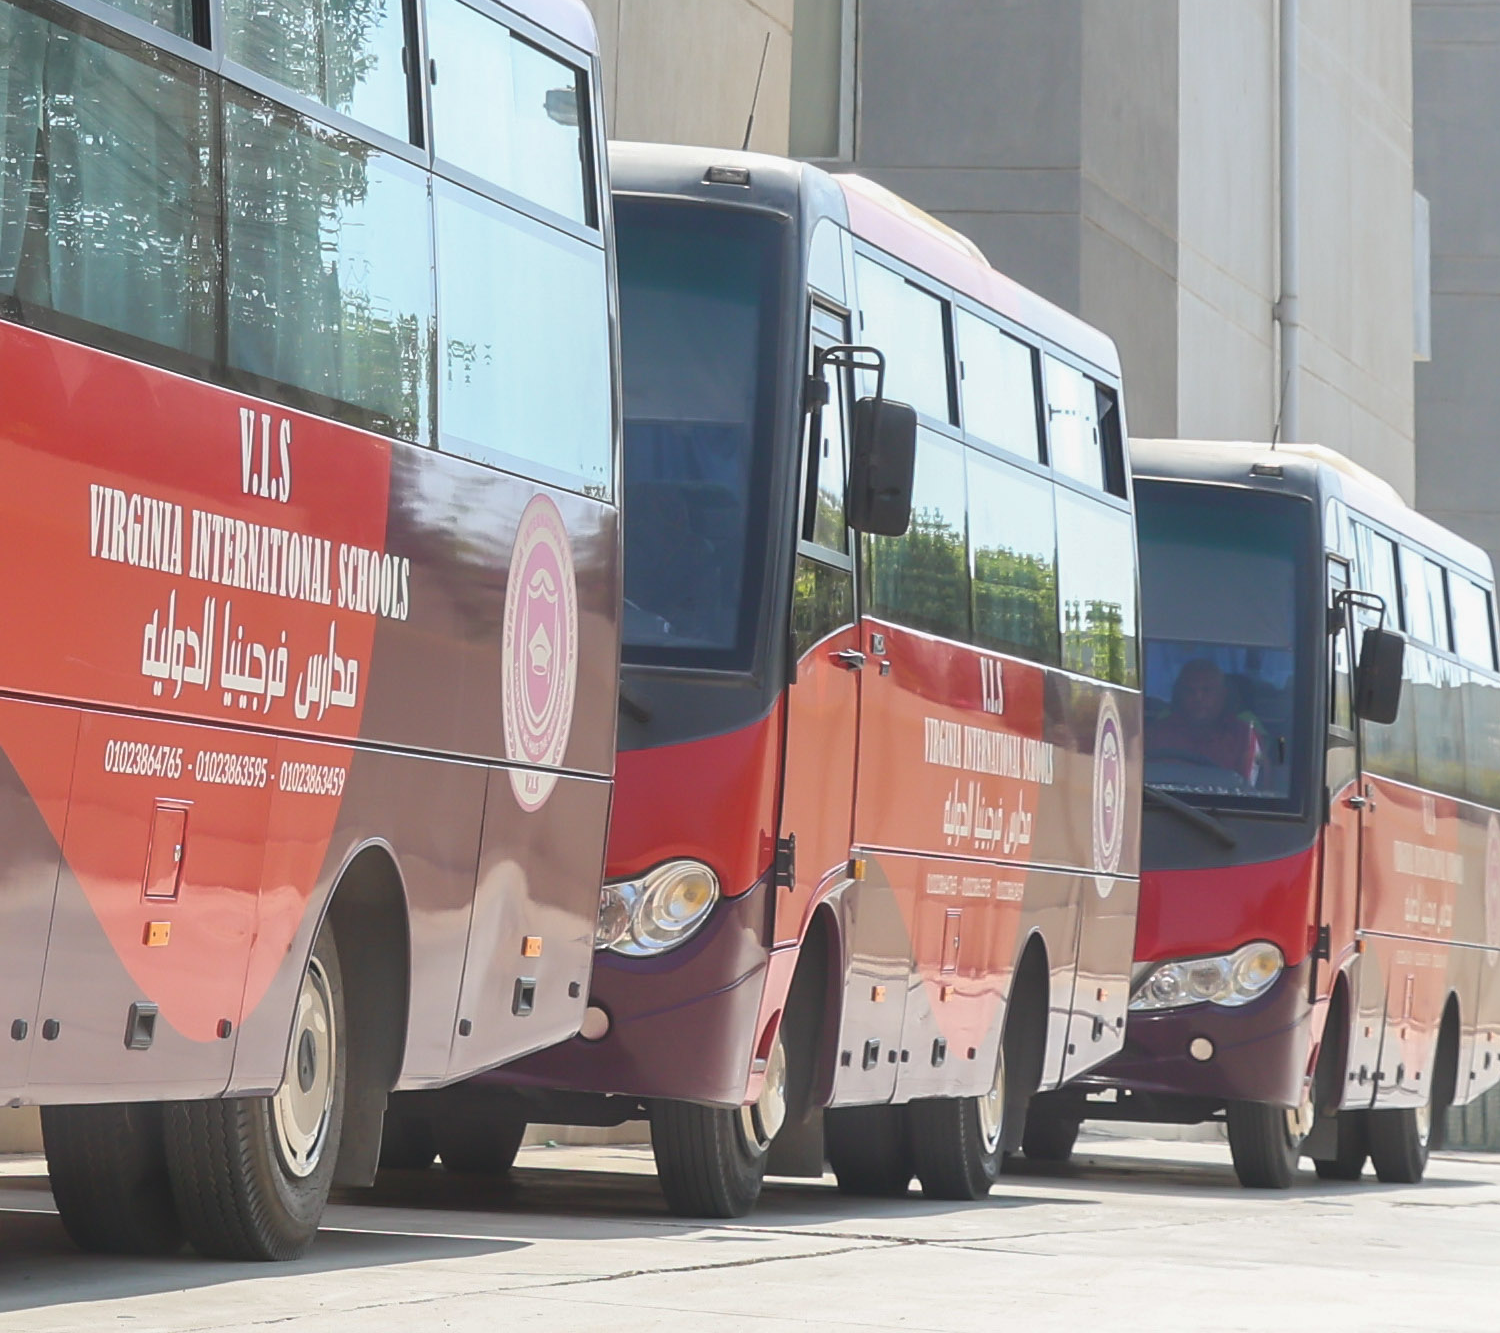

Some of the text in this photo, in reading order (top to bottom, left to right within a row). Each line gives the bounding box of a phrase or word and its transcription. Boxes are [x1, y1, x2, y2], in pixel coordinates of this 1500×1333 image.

[239, 406, 292, 503] V.I.S
[90, 483, 183, 576] VIRGINIA
[188, 508, 332, 606] INTERNATIONAL
[337, 542, 411, 621] SCHOOLS
[220, 599, 289, 715] فرجينيا
[294, 619, 360, 722] مدارس
[104, 739, 184, 779] 01023864765
[195, 750, 269, 788] 01023863595
[279, 761, 346, 797] 01023863459
